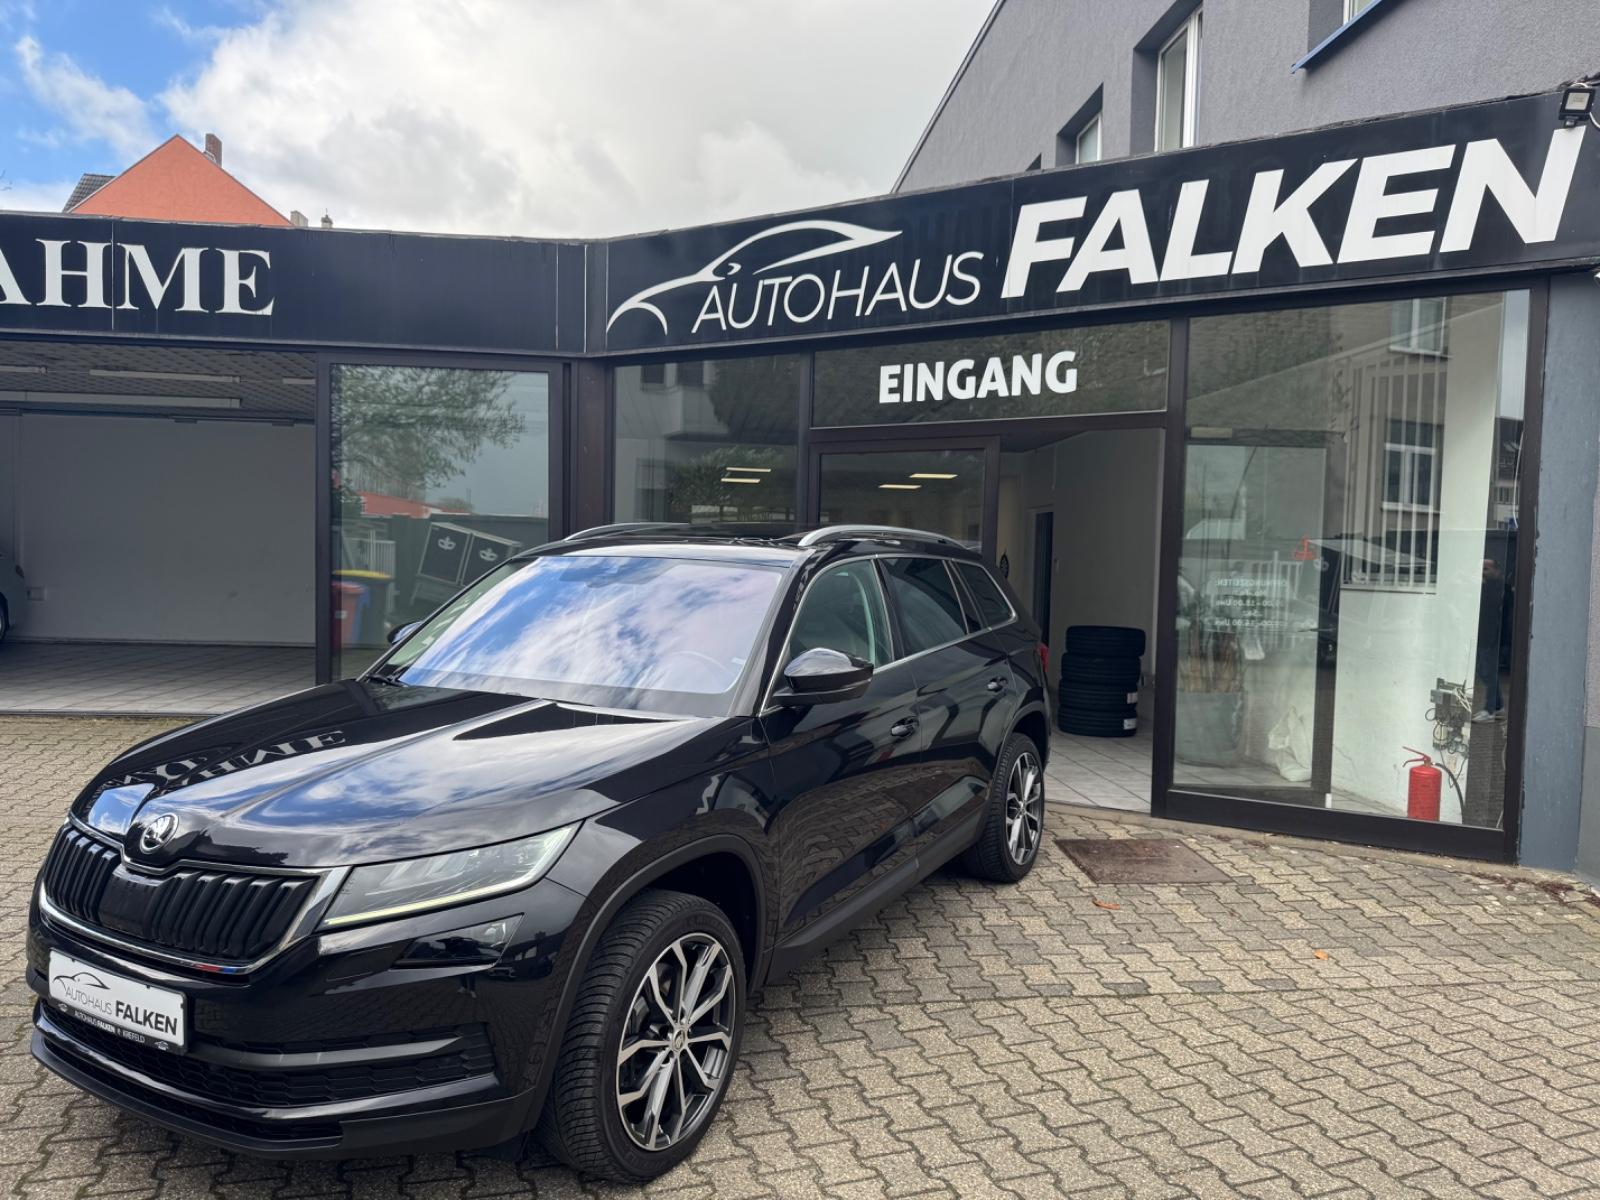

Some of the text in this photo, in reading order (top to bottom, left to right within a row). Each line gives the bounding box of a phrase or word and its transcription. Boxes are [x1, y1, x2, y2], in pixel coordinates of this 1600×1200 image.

[691, 125, 1586, 335] AUTOHAUS FALKEN
[878, 350, 1078, 405] EINGANG
[64, 985, 178, 1036] AUTOHAUS FALKEN
